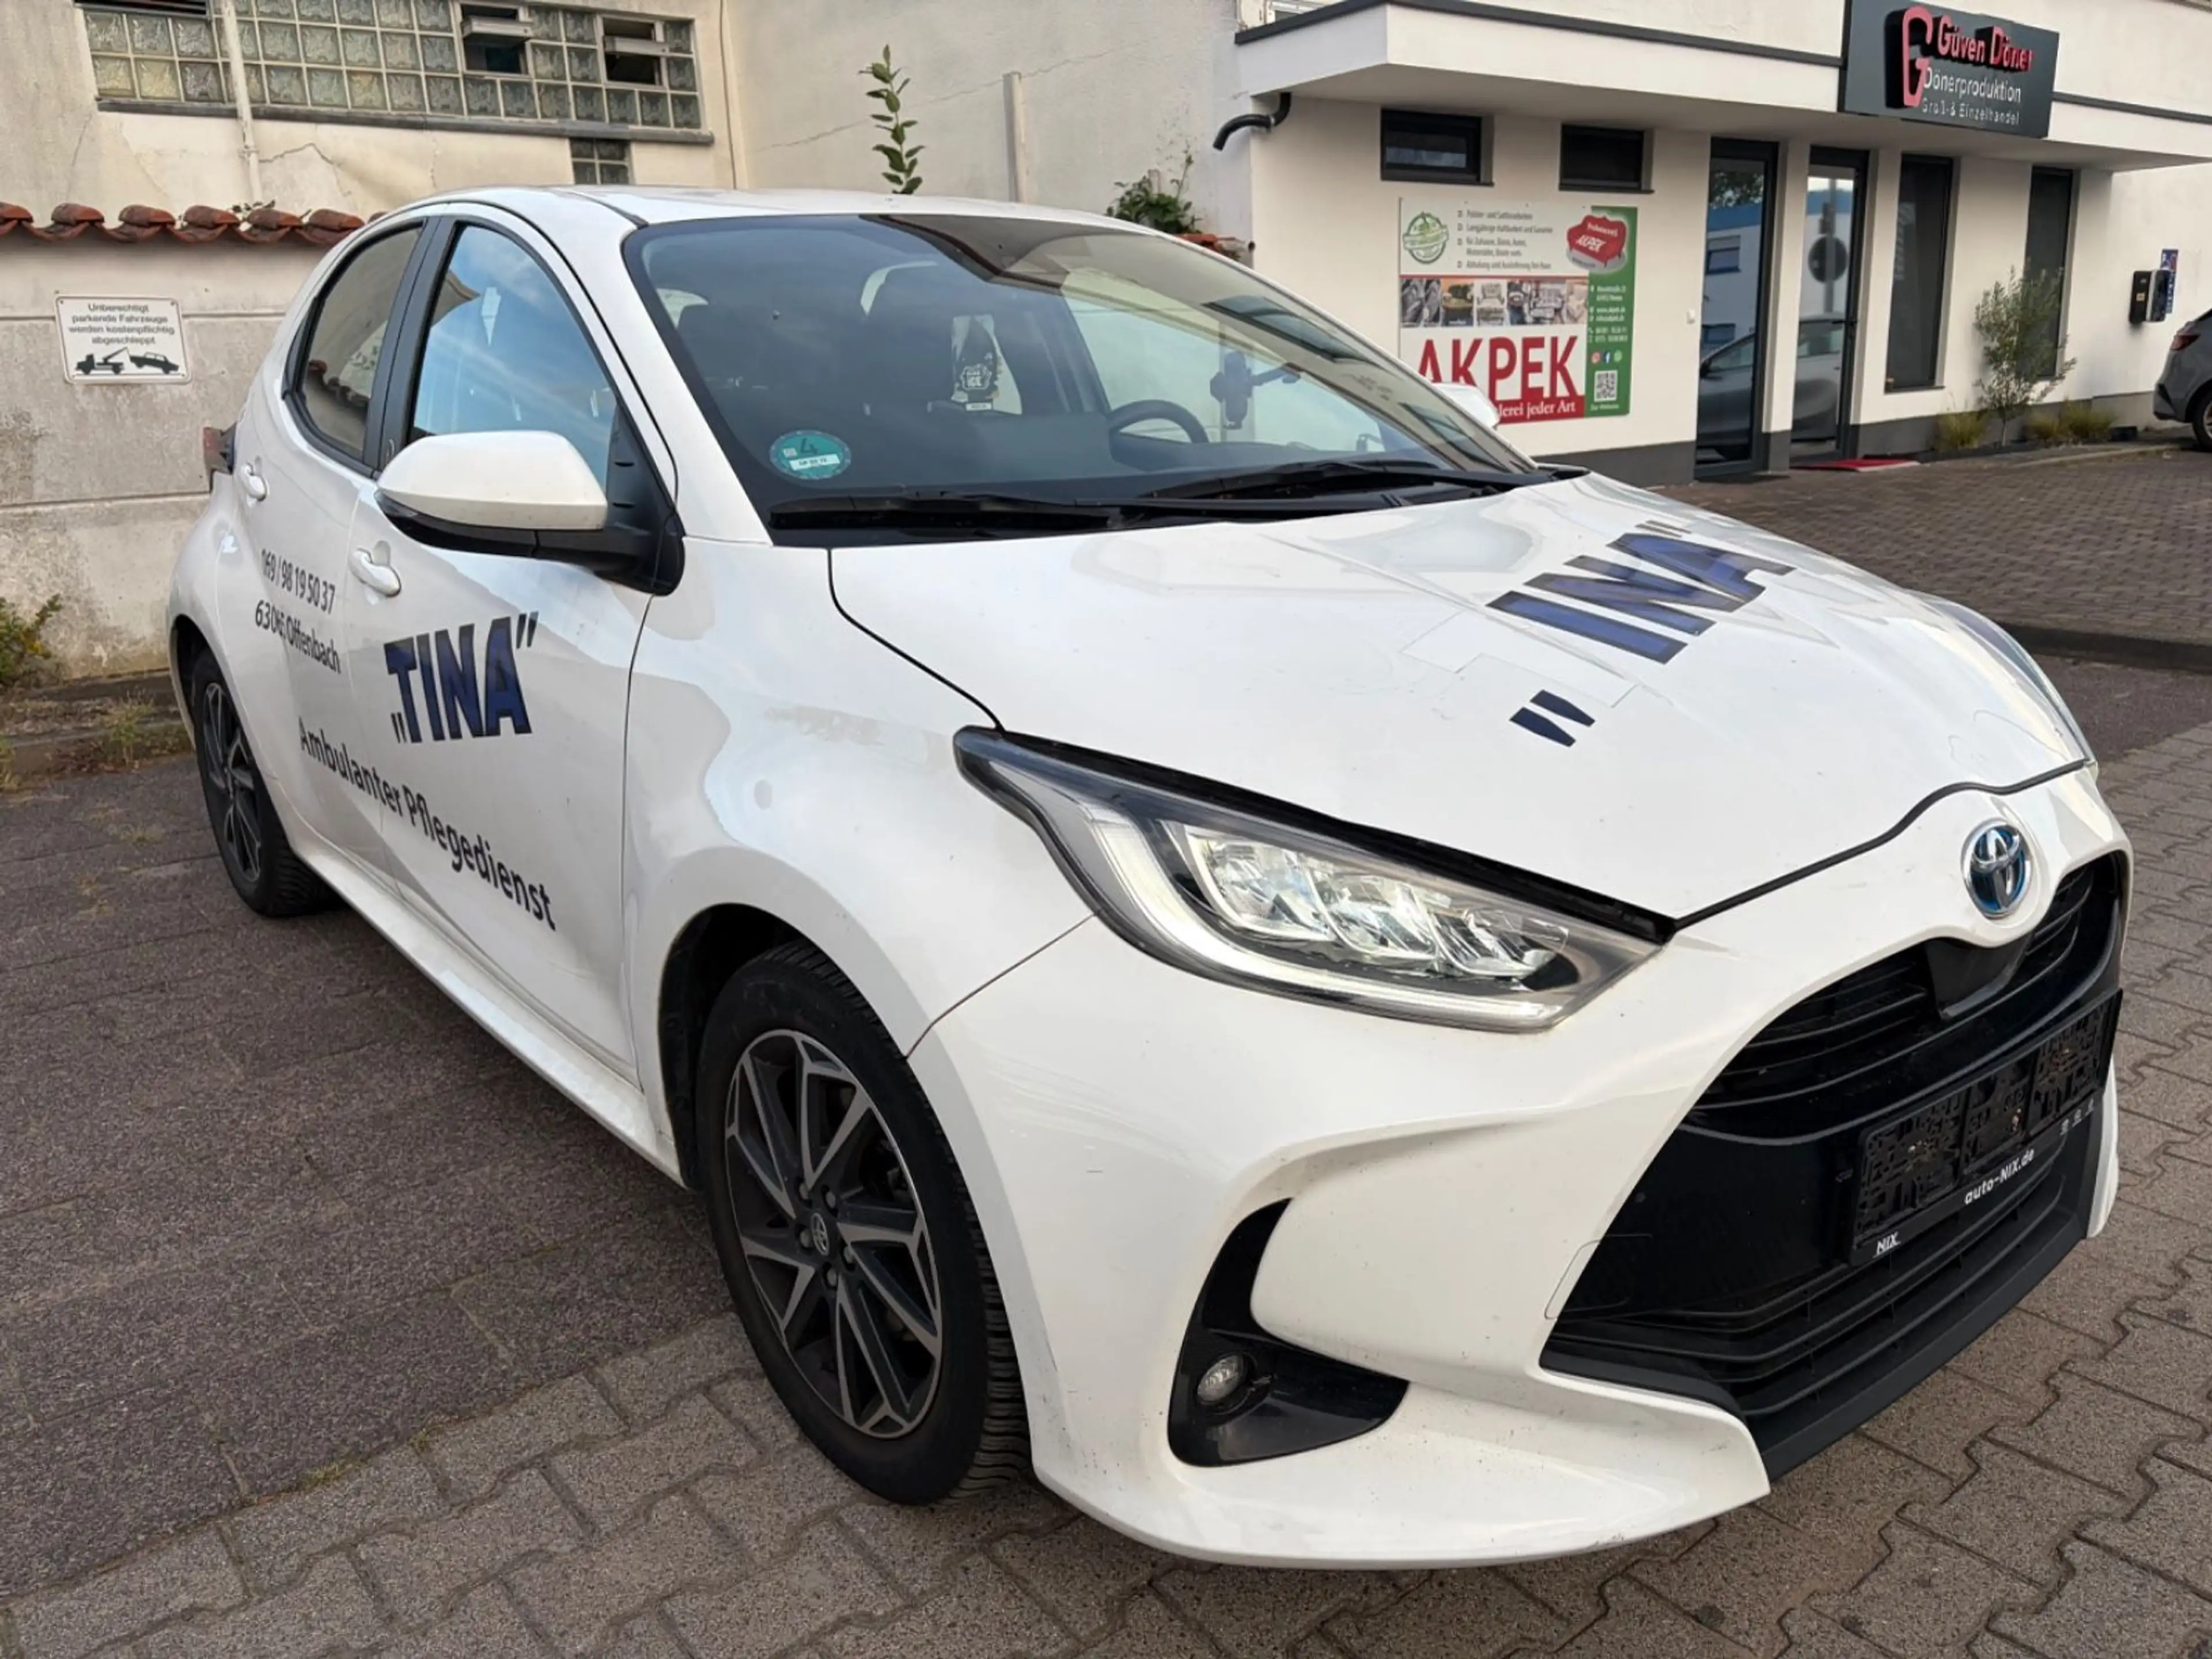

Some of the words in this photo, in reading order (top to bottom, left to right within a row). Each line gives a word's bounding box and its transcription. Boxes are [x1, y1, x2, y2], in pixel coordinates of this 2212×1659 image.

[1937, 16, 1985, 63] Güven
[1991, 26, 2033, 71] Döner
[1923, 67, 2021, 103] Dönerproduktion
[1959, 103, 2020, 126] Einzelhandel
[71, 315, 117, 324] parkende
[119, 315, 169, 324] Fahrzeuge
[88, 303, 150, 313] Unberechtigt
[67, 325, 104, 334] werden
[106, 325, 176, 335] kostenpflichtig
[91, 336, 156, 346] abgeschleppt
[1418, 336, 1581, 400] AKPEK
[1526, 400, 1555, 420] jeder
[1557, 399, 1576, 414] Art
[800, 438, 818, 454] 4
[286, 614, 342, 675] Offenbach
[298, 715, 403, 817] Ambulanter
[402, 785, 556, 931] Pflegedienst
[1964, 1147, 2035, 1205] auto-NIX.de
